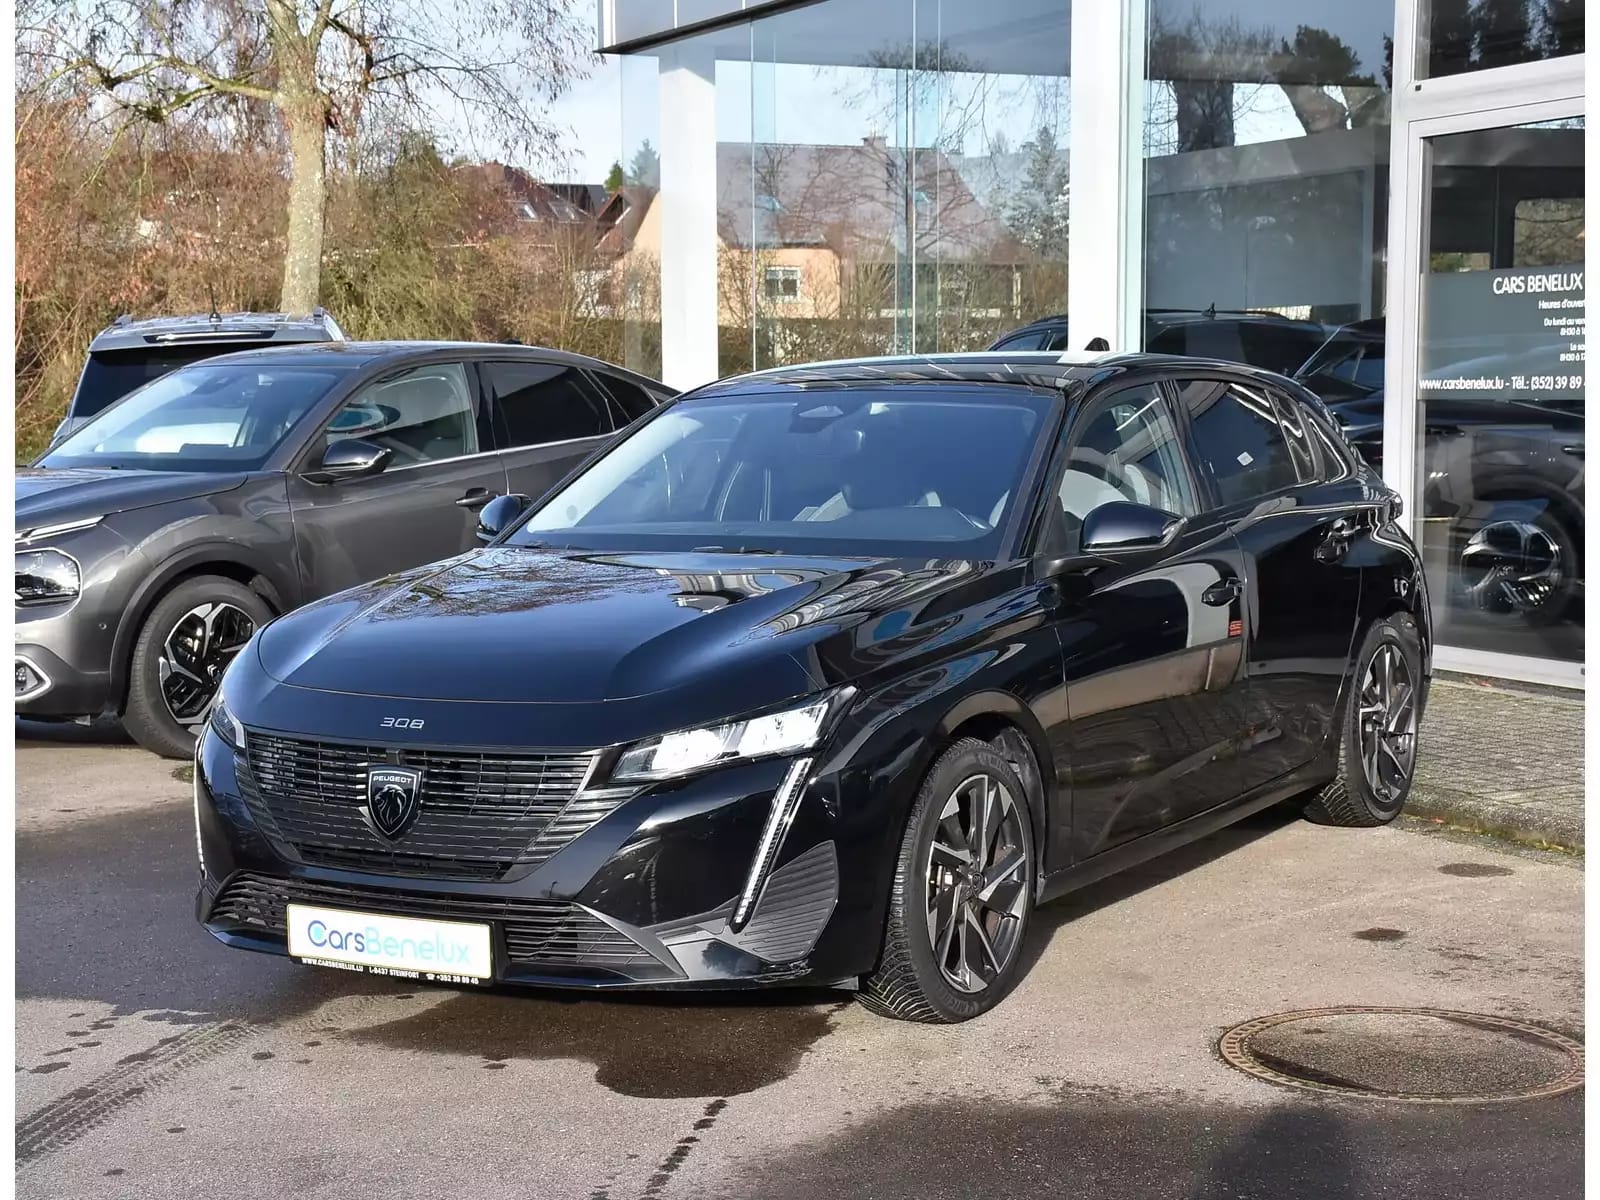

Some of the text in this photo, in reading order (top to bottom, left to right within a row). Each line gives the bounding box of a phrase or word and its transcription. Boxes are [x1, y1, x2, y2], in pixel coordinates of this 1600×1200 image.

[1493, 273, 1583, 294] CARS BENELUX
[1538, 300, 1561, 309] Heures
[1543, 318, 1552, 326] Du
[1419, 376, 1504, 390] www.carsbenelux.lu
[1531, 376, 1554, 390] (352)
[1554, 376, 1568, 389] 39
[1569, 376, 1582, 389] 89
[380, 717, 424, 728] 308
[373, 775, 412, 784] PEUGEOT
[307, 919, 470, 964] CarsBenelux
